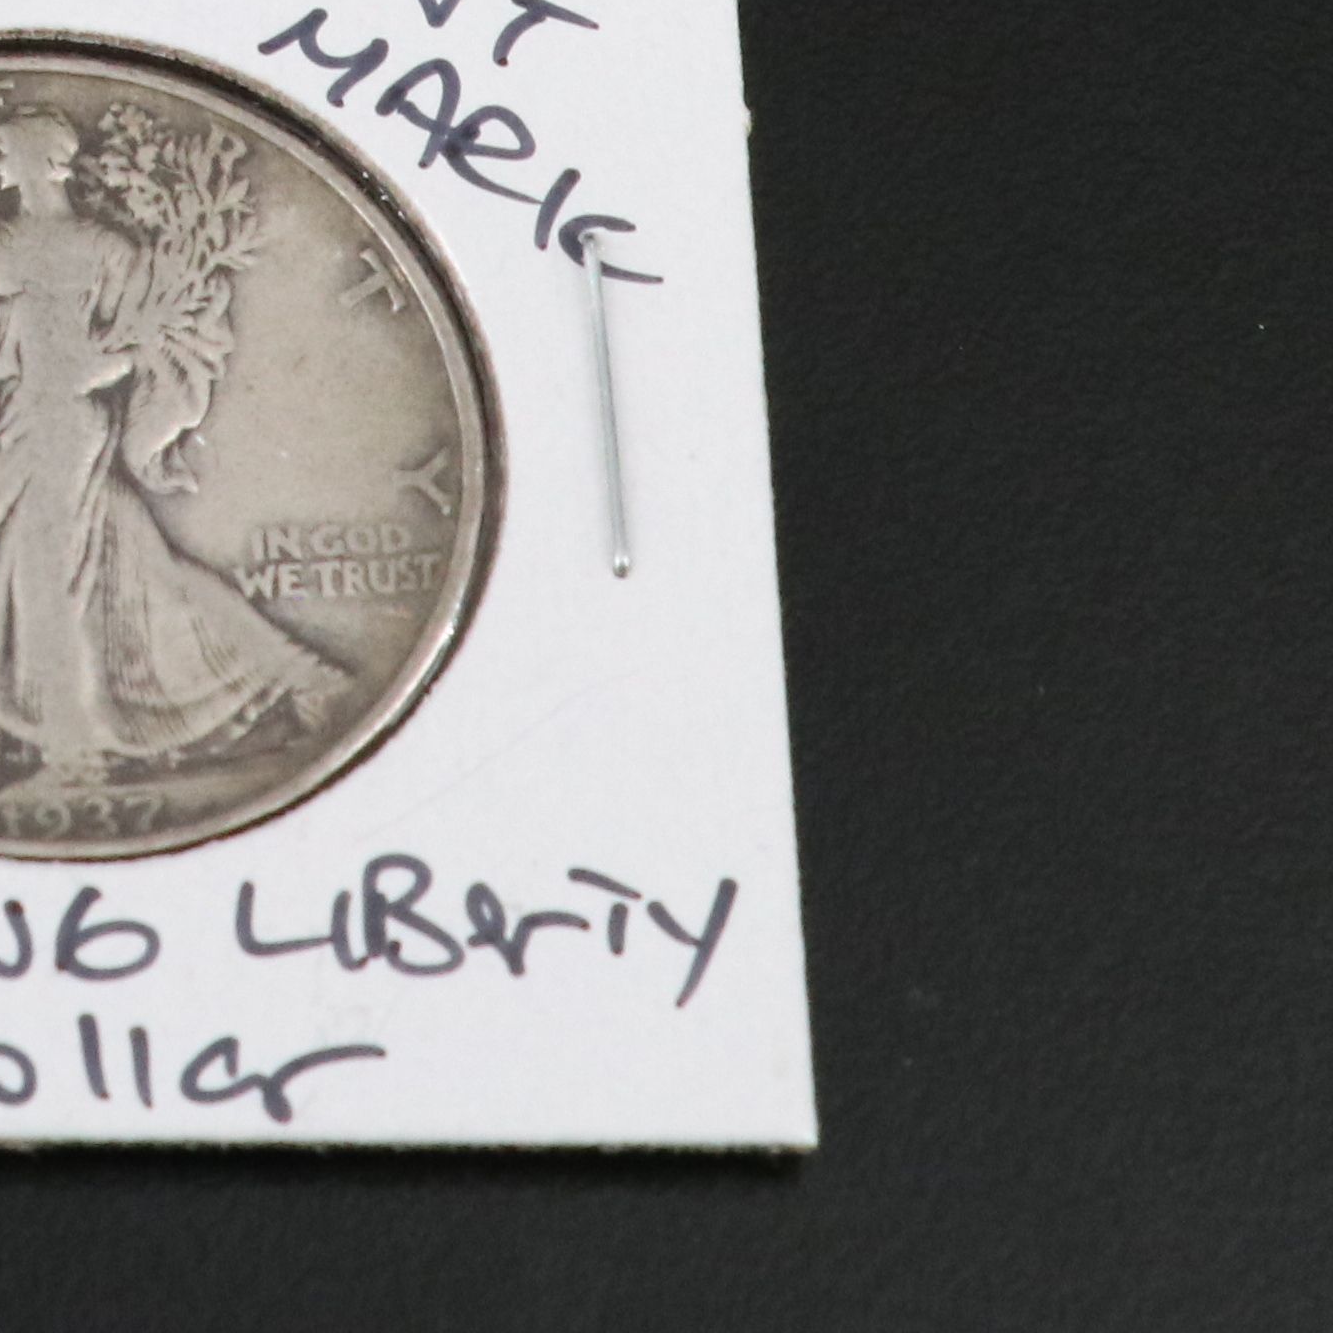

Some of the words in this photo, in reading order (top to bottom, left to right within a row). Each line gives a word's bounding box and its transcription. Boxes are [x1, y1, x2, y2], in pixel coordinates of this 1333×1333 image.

[257, 7, 664, 284] MARK
[250, 525, 303, 561] IN
[308, 522, 411, 557] GOD
[235, 563, 308, 599] WE
[310, 553, 442, 598] TRUST
[1, 794, 165, 838] 1937
